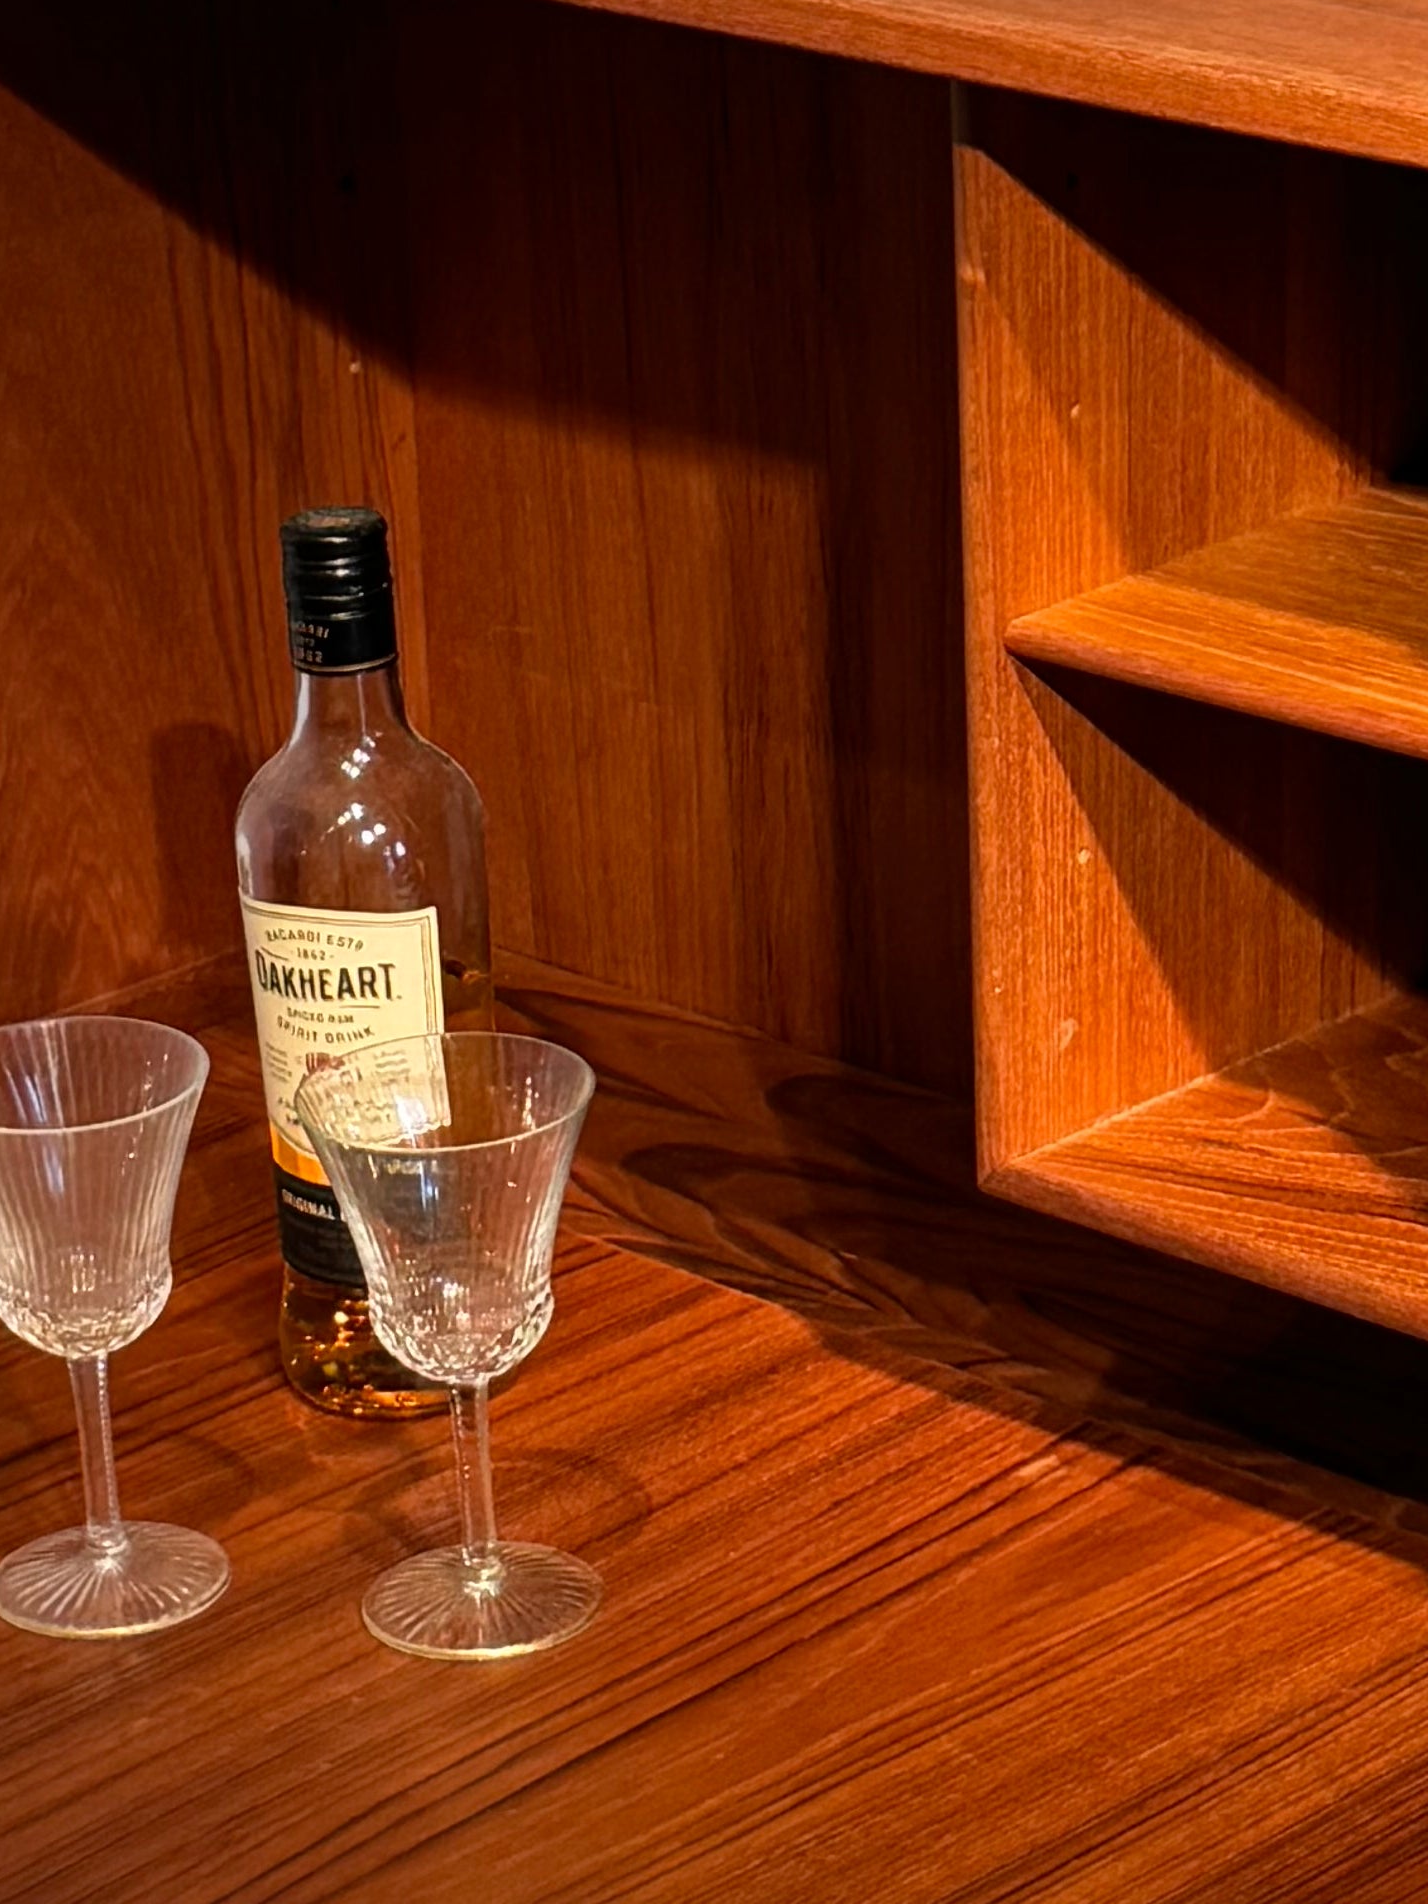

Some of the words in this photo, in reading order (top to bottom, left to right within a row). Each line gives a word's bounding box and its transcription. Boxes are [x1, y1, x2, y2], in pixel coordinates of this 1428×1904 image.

[255, 949, 397, 1003] OAKHEART
[276, 1015, 318, 1043] SPIRIT
[324, 1024, 376, 1045] DRINK
